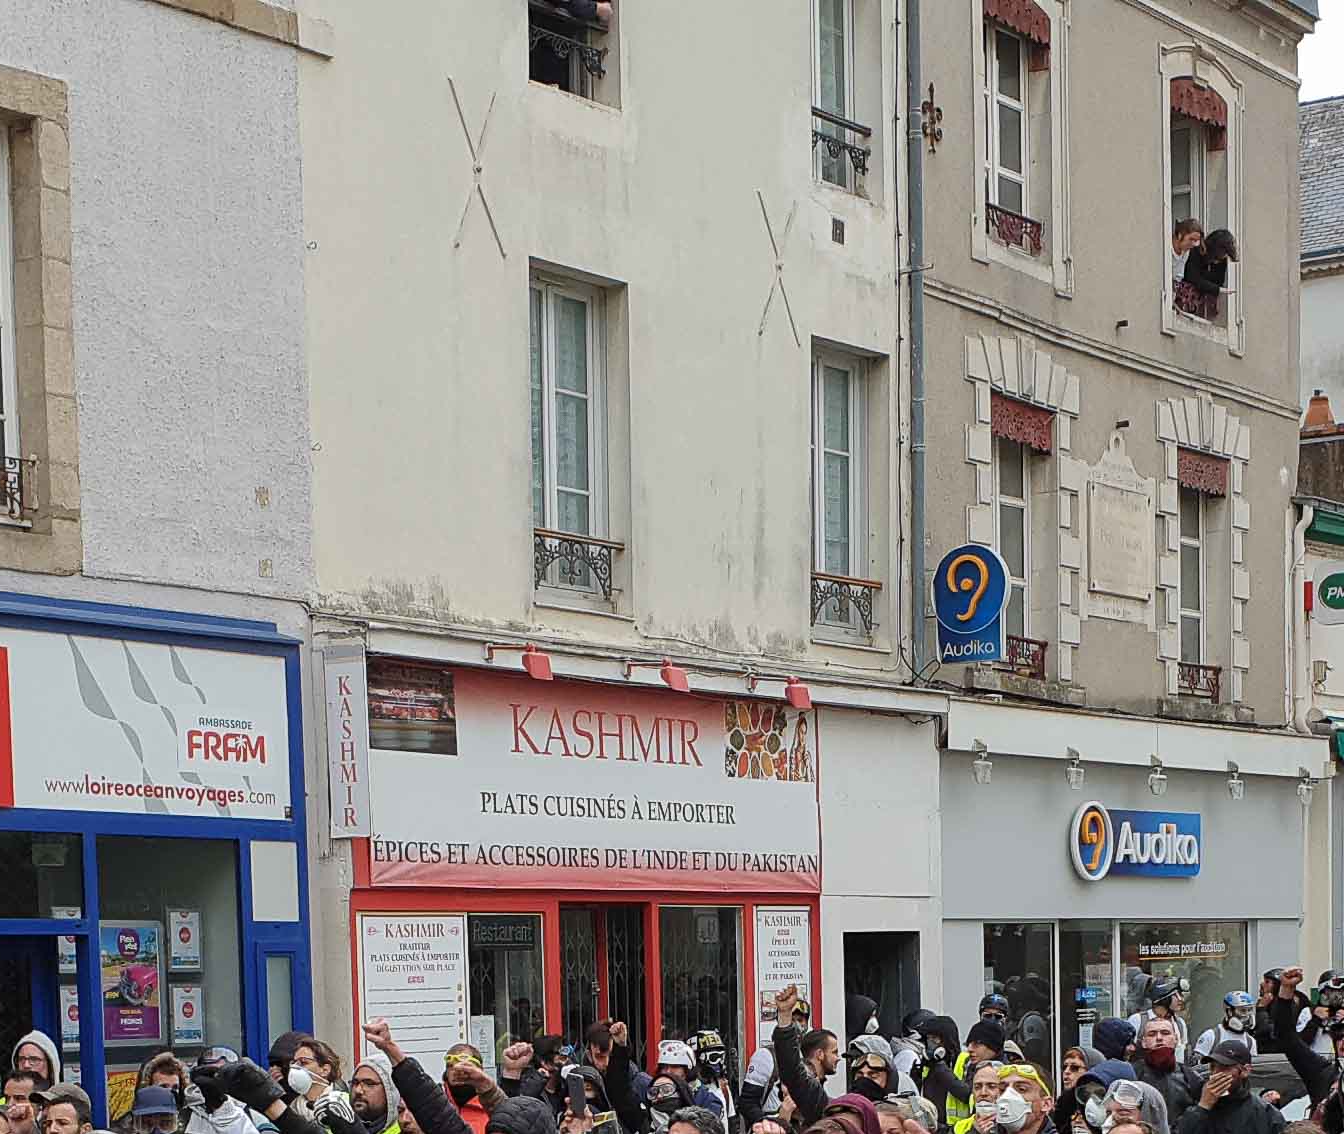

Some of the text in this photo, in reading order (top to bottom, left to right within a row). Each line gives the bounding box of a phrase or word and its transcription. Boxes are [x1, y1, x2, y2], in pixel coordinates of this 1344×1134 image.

[942, 639, 996, 659] Audika
[198, 717, 254, 730] AMBASSADE
[509, 703, 704, 767] KASHMIR
[186, 728, 266, 765] FRAM
[337, 675, 358, 827] KASHMIR
[44, 774, 277, 809] www.loireoceanvoyages.com
[480, 791, 737, 825] PLATS CUISINÉS À EMPORTER
[373, 833, 819, 875] ÉPICES ET ACCESSOIRES DE L'INDE ET DU PAKISTAN
[1114, 821, 1199, 866] Audika
[384, 923, 446, 939] KASHMIR
[471, 919, 533, 942] Restaurant
